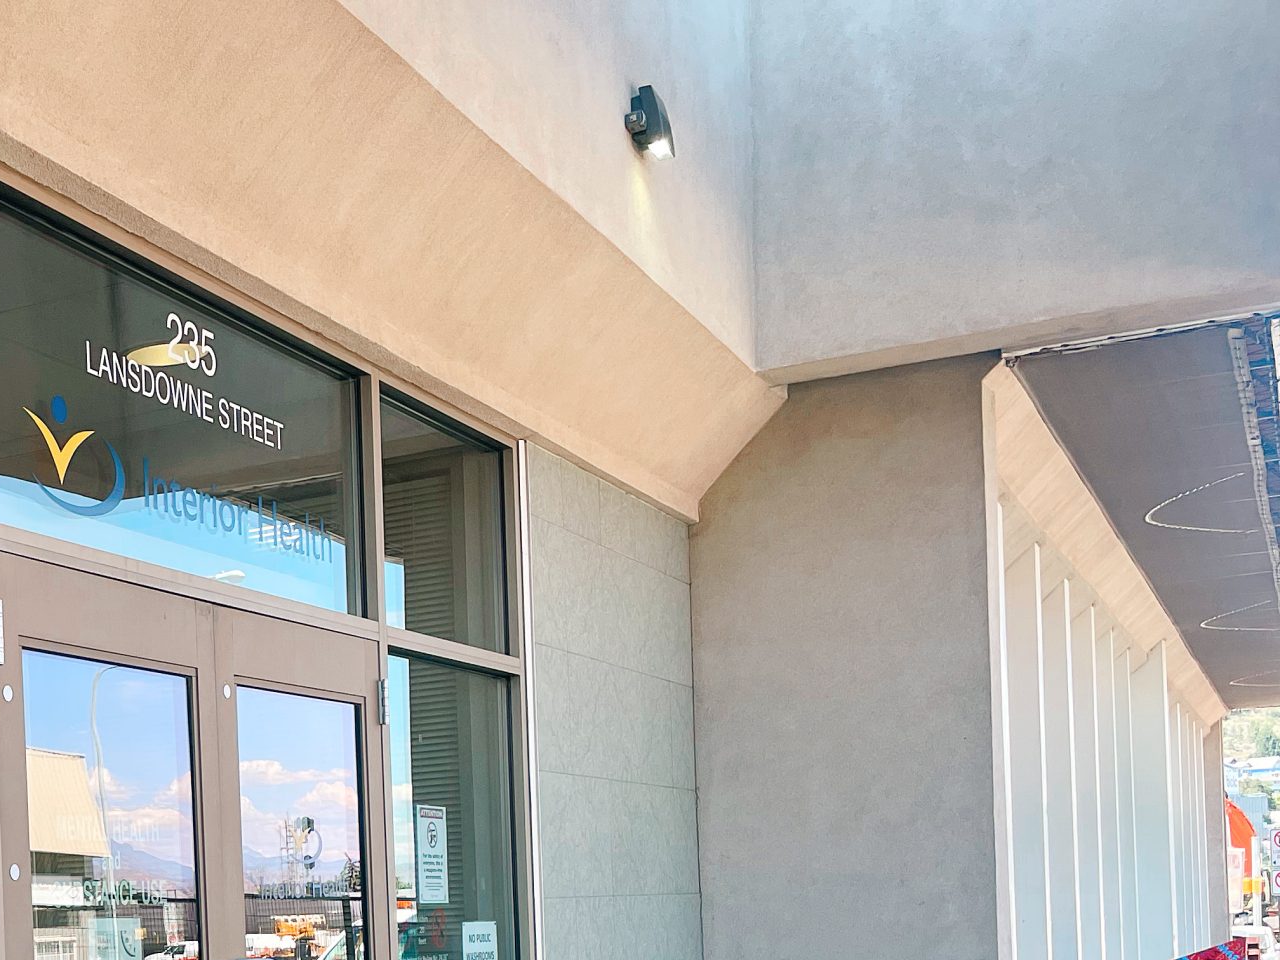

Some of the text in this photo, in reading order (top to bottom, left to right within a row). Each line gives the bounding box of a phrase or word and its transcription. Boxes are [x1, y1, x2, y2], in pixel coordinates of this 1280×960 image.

[166, 313, 217, 377] 235
[85, 341, 284, 450] LANSDOWNE STREET
[143, 456, 333, 563] Interior Health
[466, 950, 495, 960] WASHROOMS
[469, 933, 491, 943] NO PUBLIC
